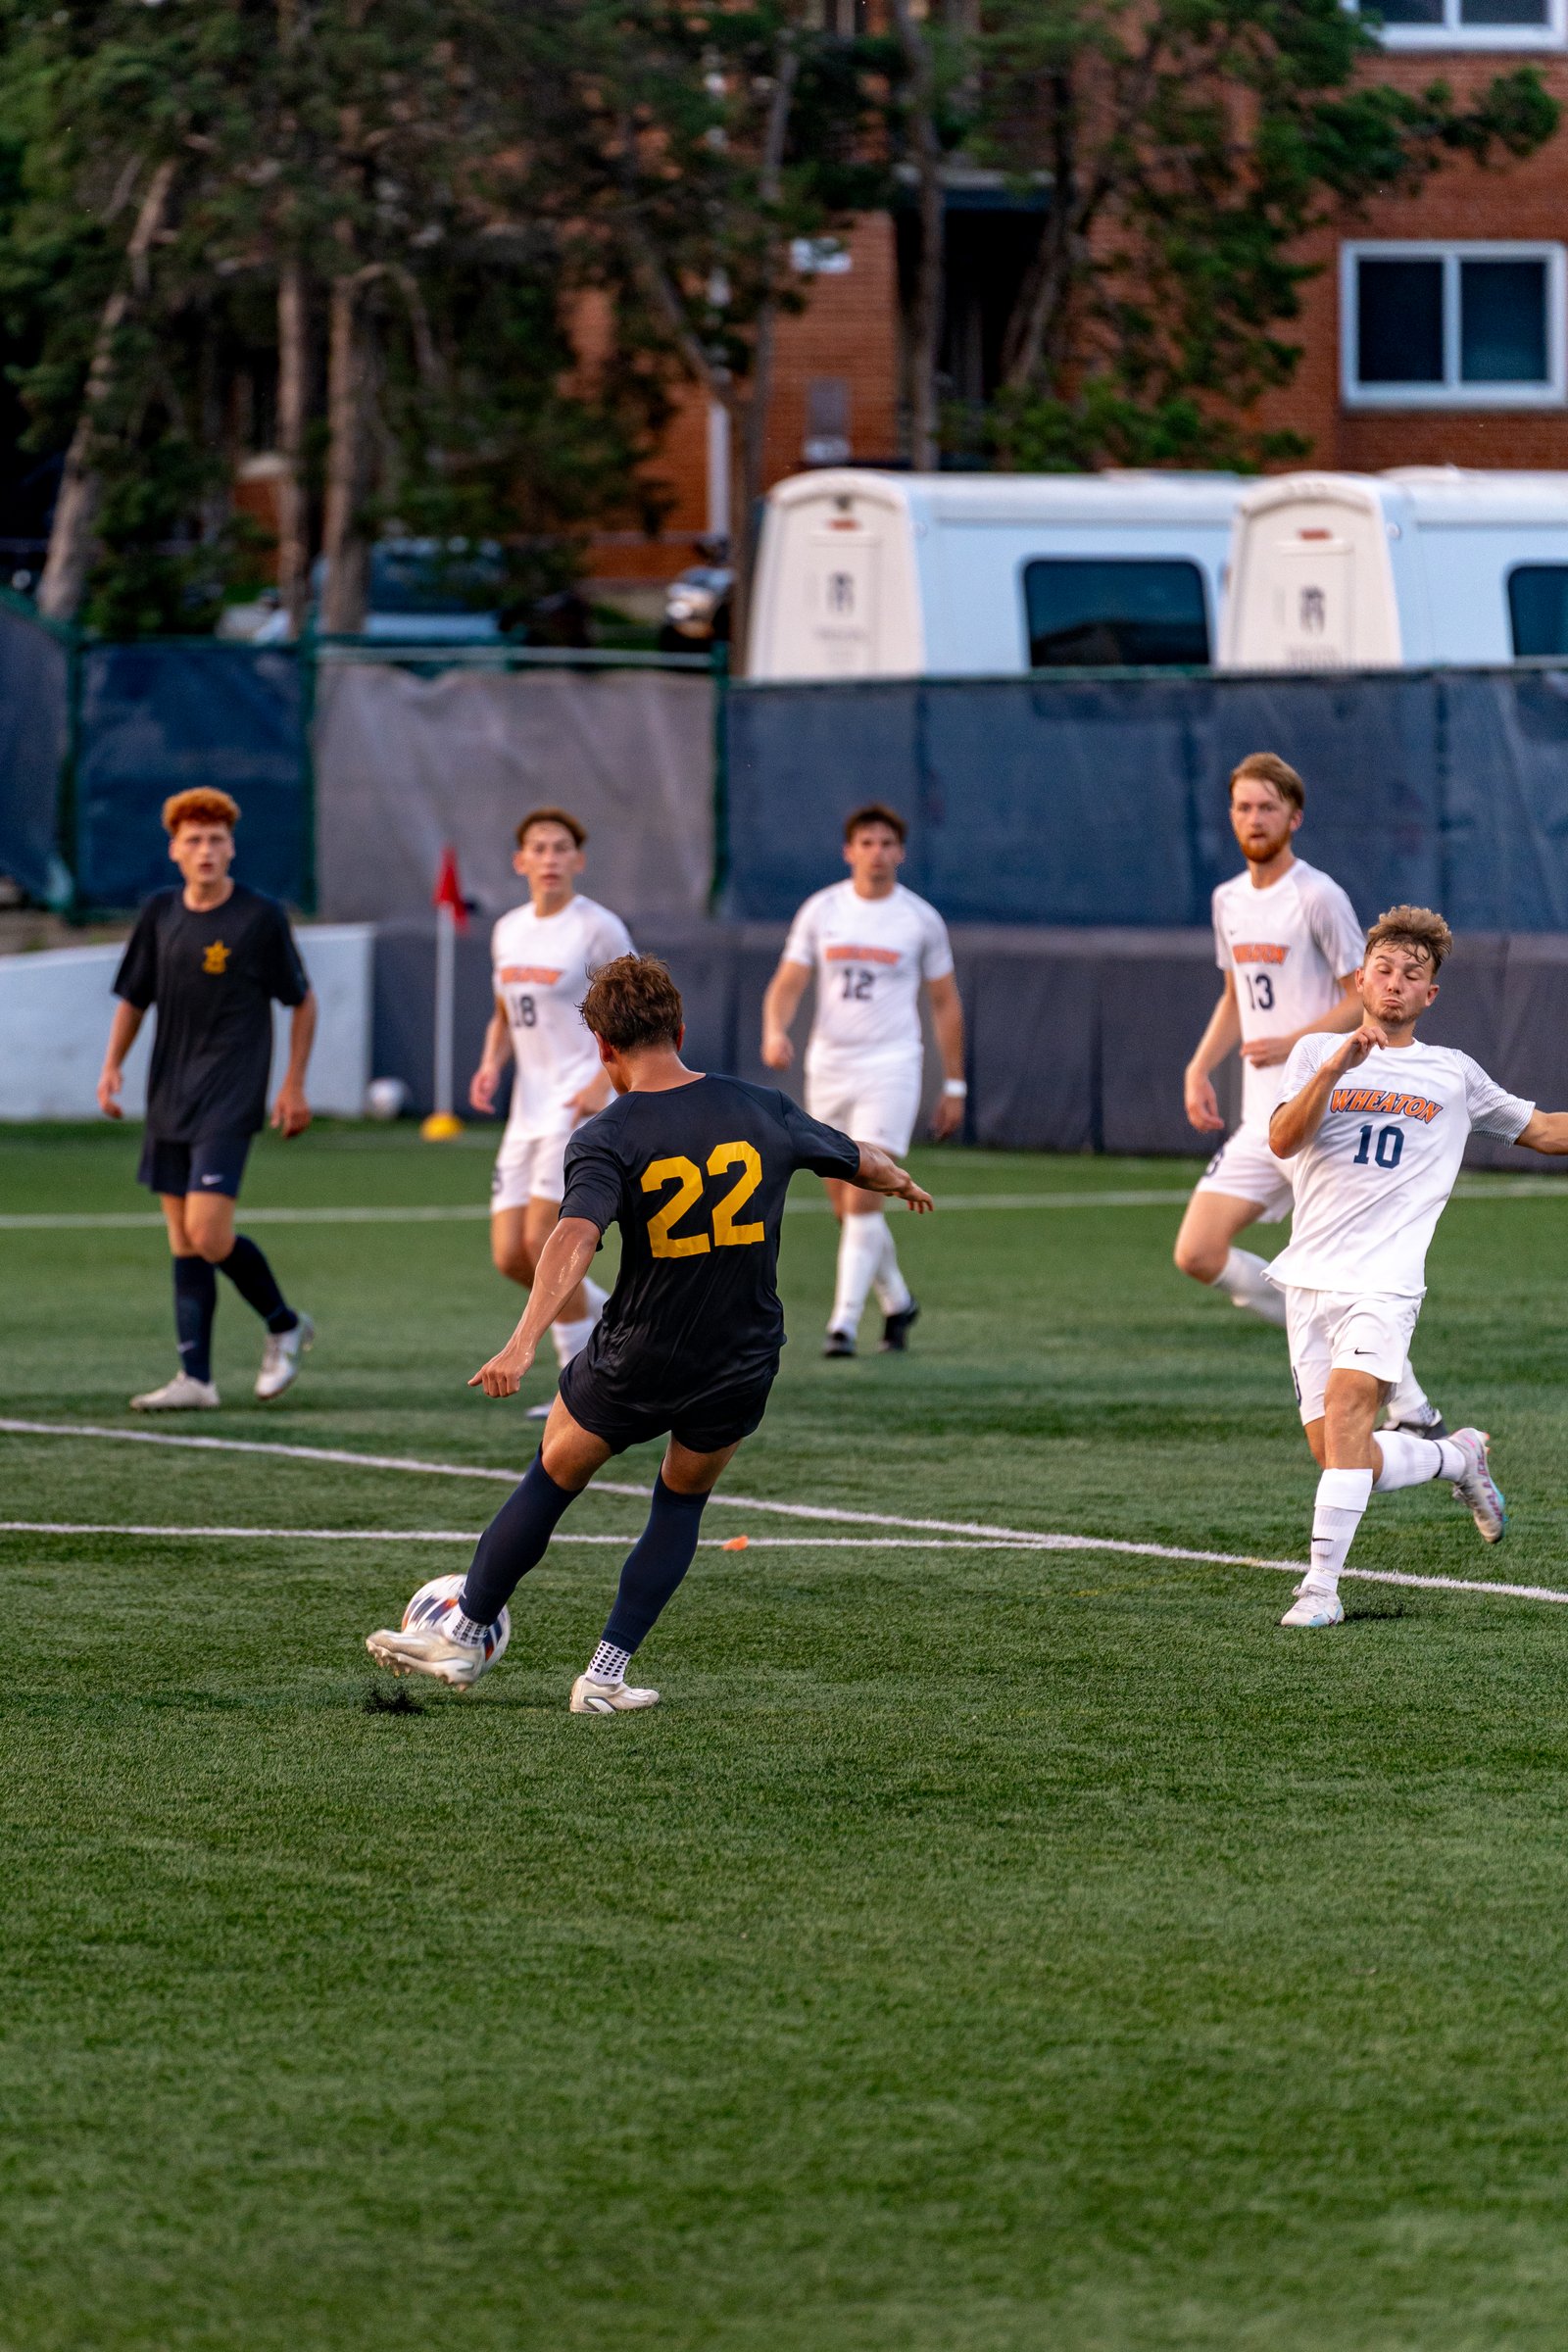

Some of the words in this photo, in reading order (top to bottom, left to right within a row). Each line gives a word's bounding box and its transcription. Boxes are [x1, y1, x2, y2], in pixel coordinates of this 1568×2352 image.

[842, 966, 875, 1000] 12
[1246, 973, 1275, 1010] 13
[1330, 1088, 1444, 1124] WHEATON
[1352, 1124, 1405, 1169] 10
[640, 1140, 765, 1258] 22
